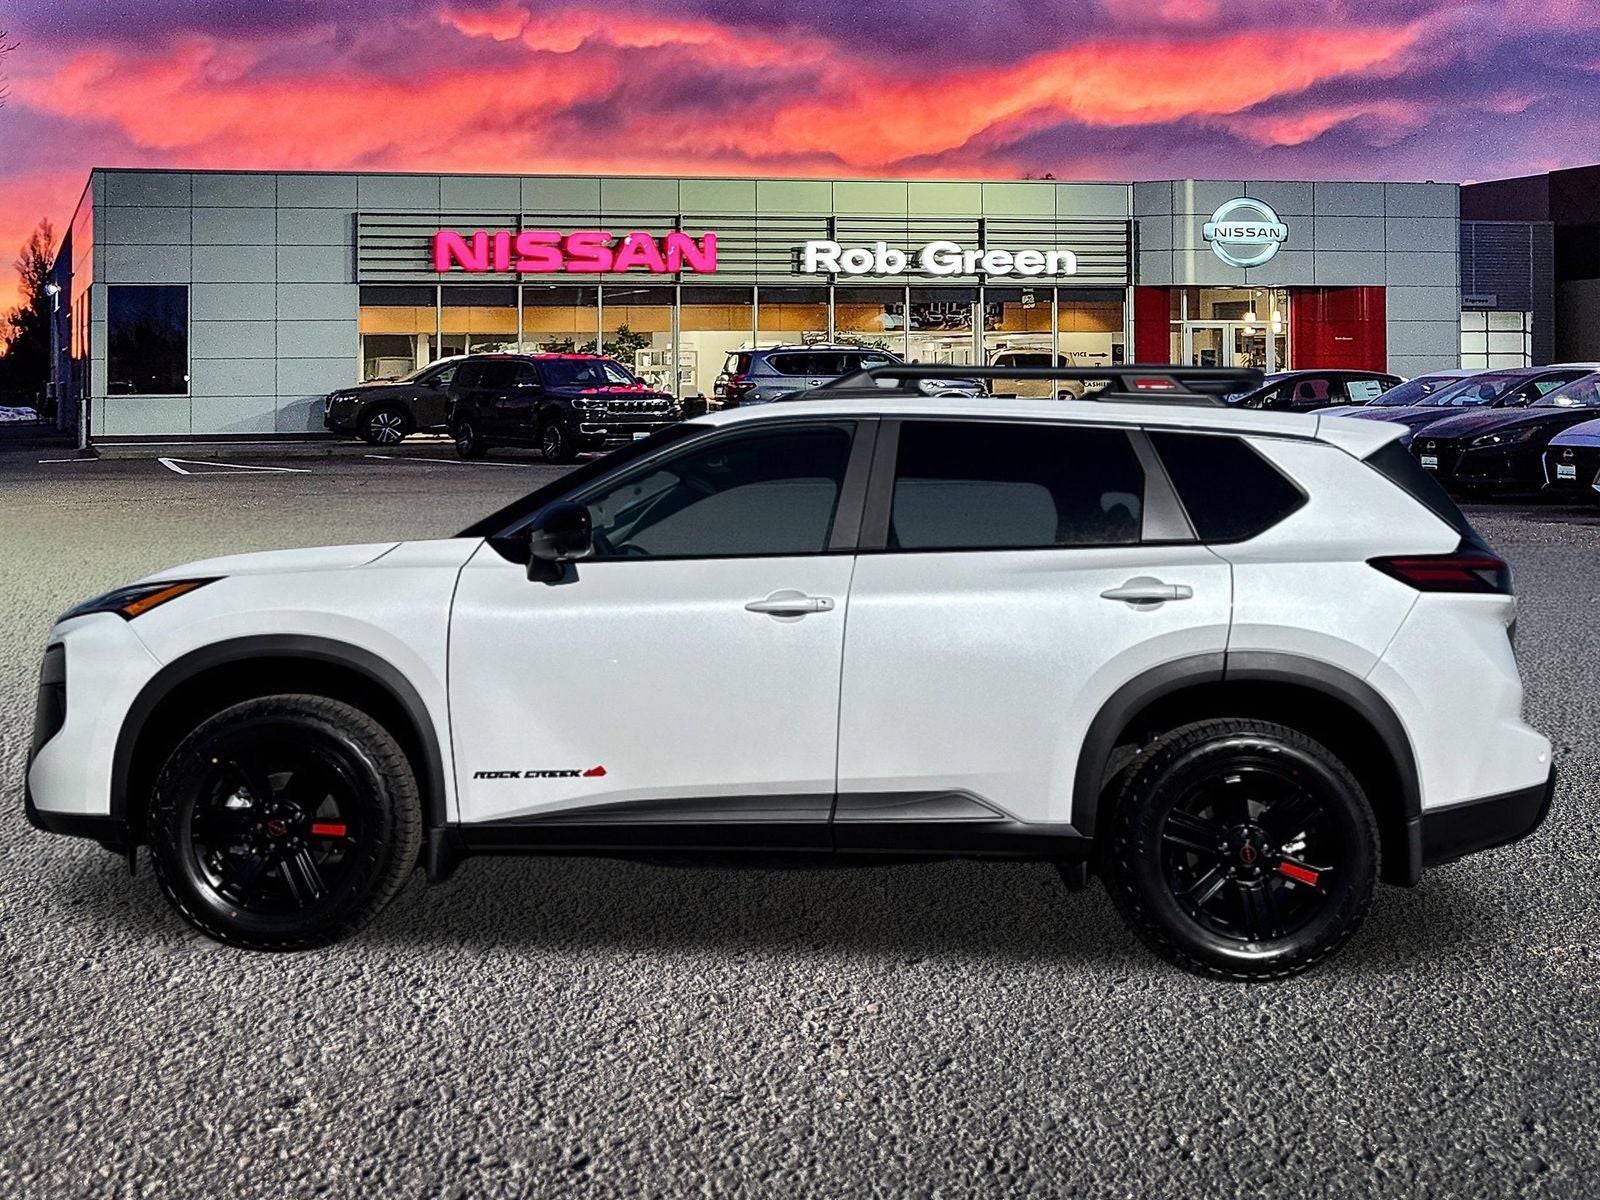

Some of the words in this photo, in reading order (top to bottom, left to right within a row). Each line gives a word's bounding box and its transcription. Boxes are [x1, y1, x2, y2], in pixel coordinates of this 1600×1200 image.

[1214, 227, 1280, 238] NISSAN
[434, 230, 718, 273] NISSAN
[804, 240, 907, 275] Rob
[920, 240, 1079, 276] Green
[473, 771, 522, 779] ROCK
[524, 769, 582, 778] CREEK
